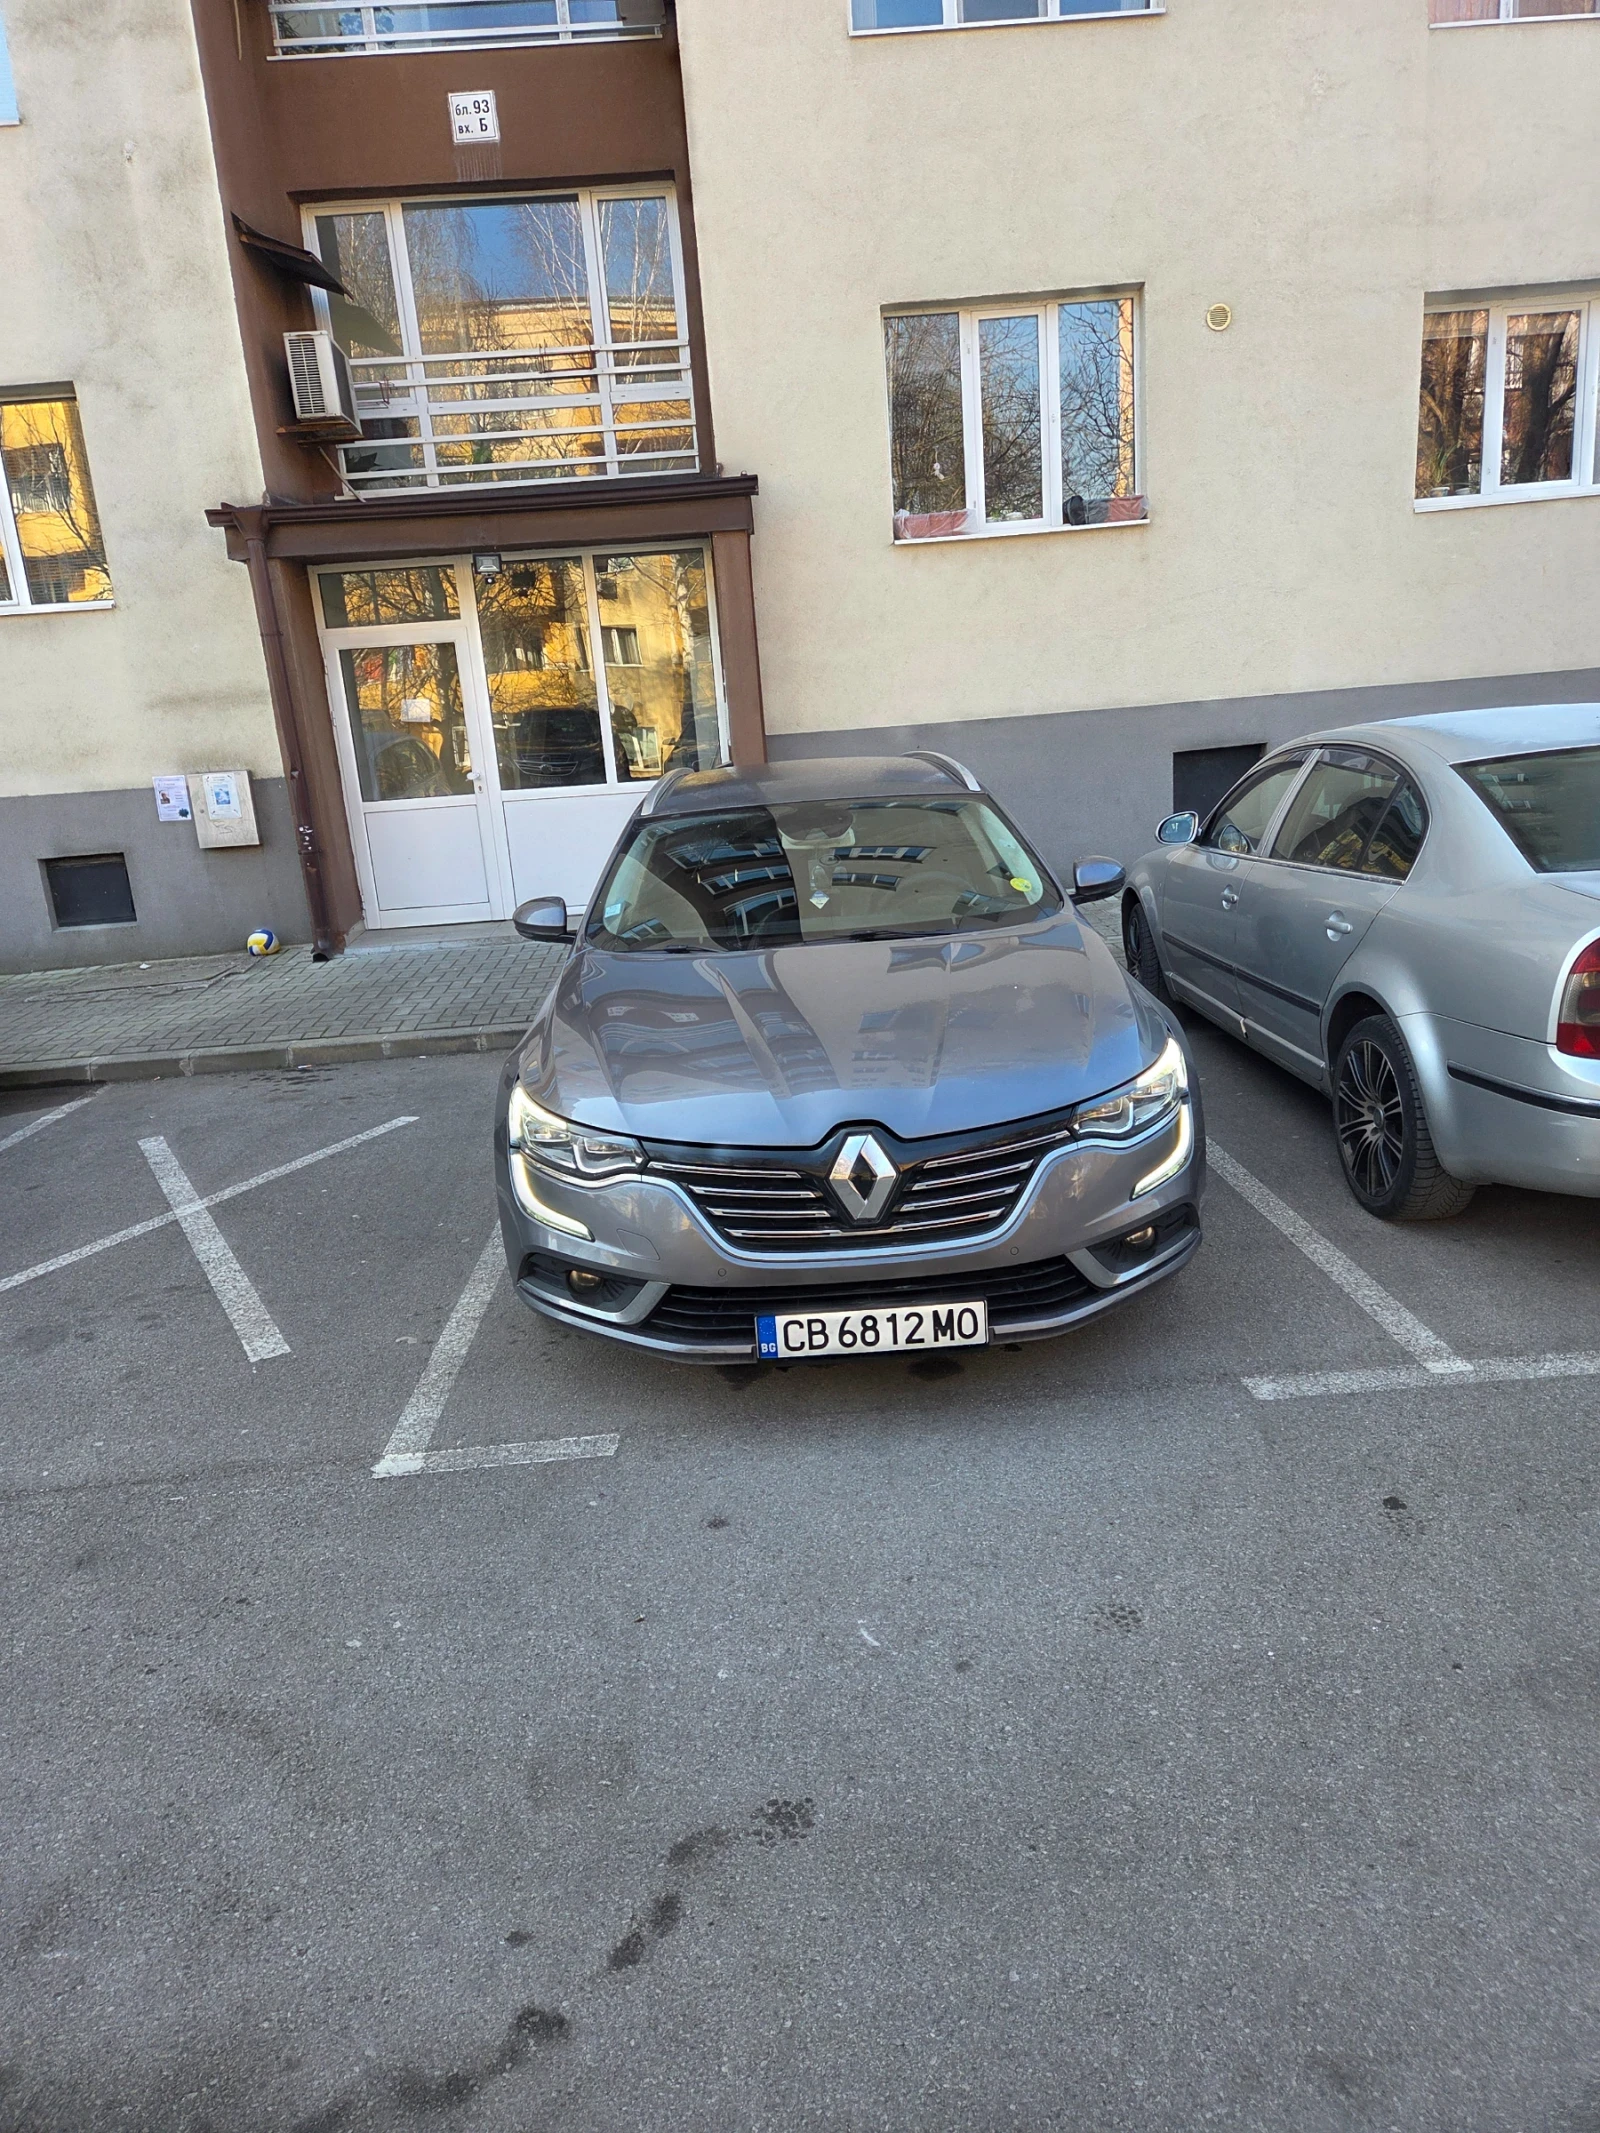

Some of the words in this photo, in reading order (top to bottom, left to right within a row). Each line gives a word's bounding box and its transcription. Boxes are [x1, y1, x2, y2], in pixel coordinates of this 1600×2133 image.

[455, 104, 472, 116] бл.
[473, 99, 490, 114] 93
[458, 125, 474, 134] вх.
[479, 117, 488, 132] Б
[761, 1343, 776, 1353] BG
